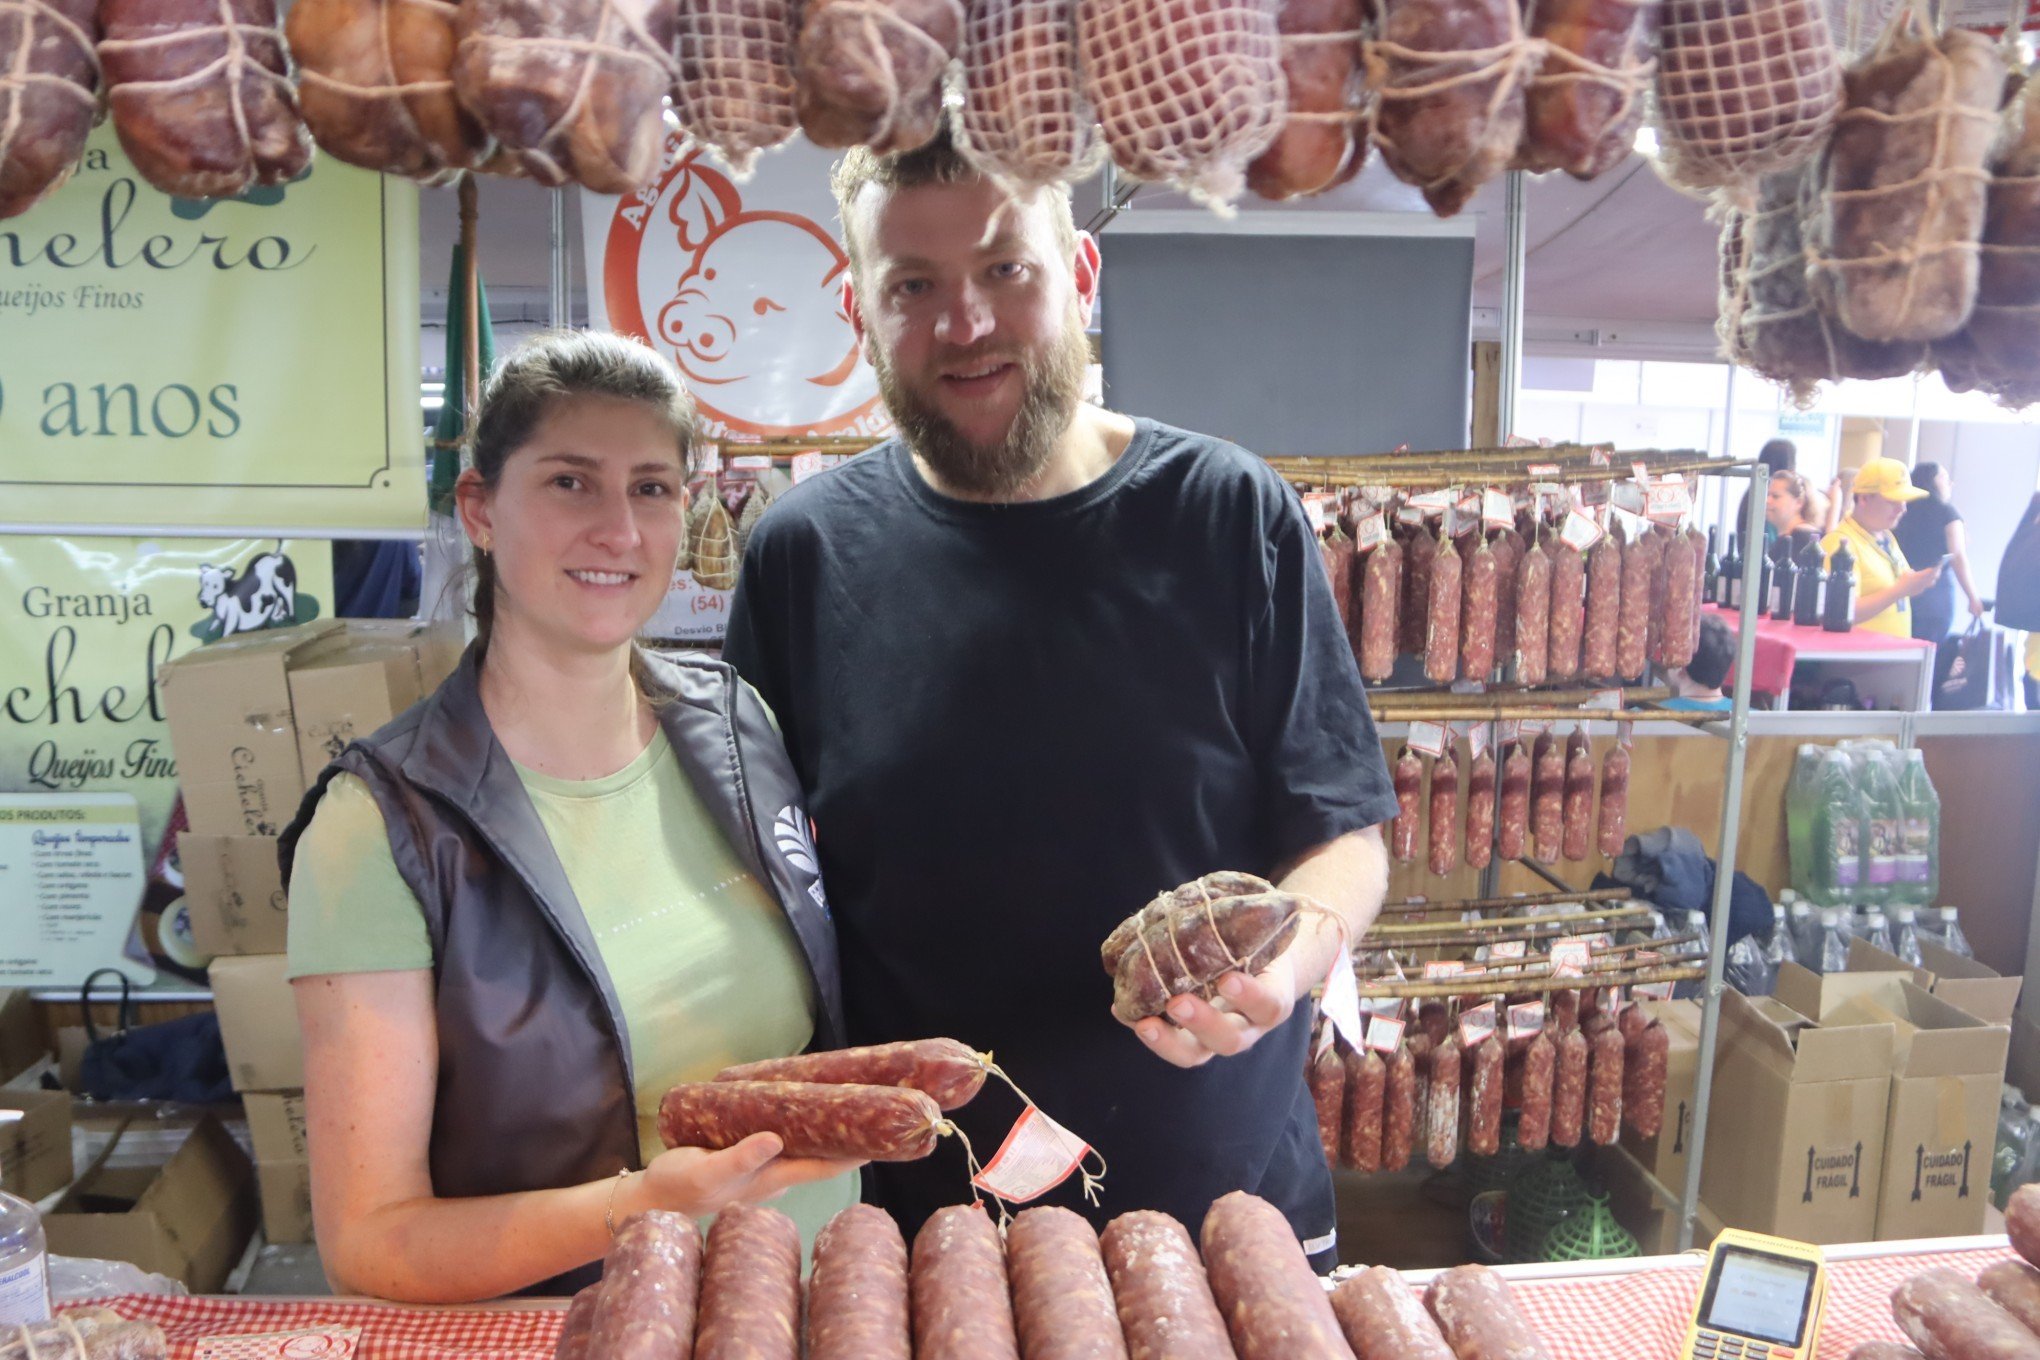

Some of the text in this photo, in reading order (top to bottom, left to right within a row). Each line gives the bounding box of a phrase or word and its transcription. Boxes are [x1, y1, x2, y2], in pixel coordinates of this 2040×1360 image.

[0, 282, 144, 316] ueijos Finos
[40, 381, 241, 438] anos
[22, 585, 153, 625] Granja
[691, 594, 724, 615] (54)
[674, 623, 713, 635] Desvio
[0, 623, 174, 725] chel
[29, 739, 114, 789] Queijos
[1814, 1154, 1854, 1170] CUIDADO
[1923, 1153, 1963, 1169] CUIDADO
